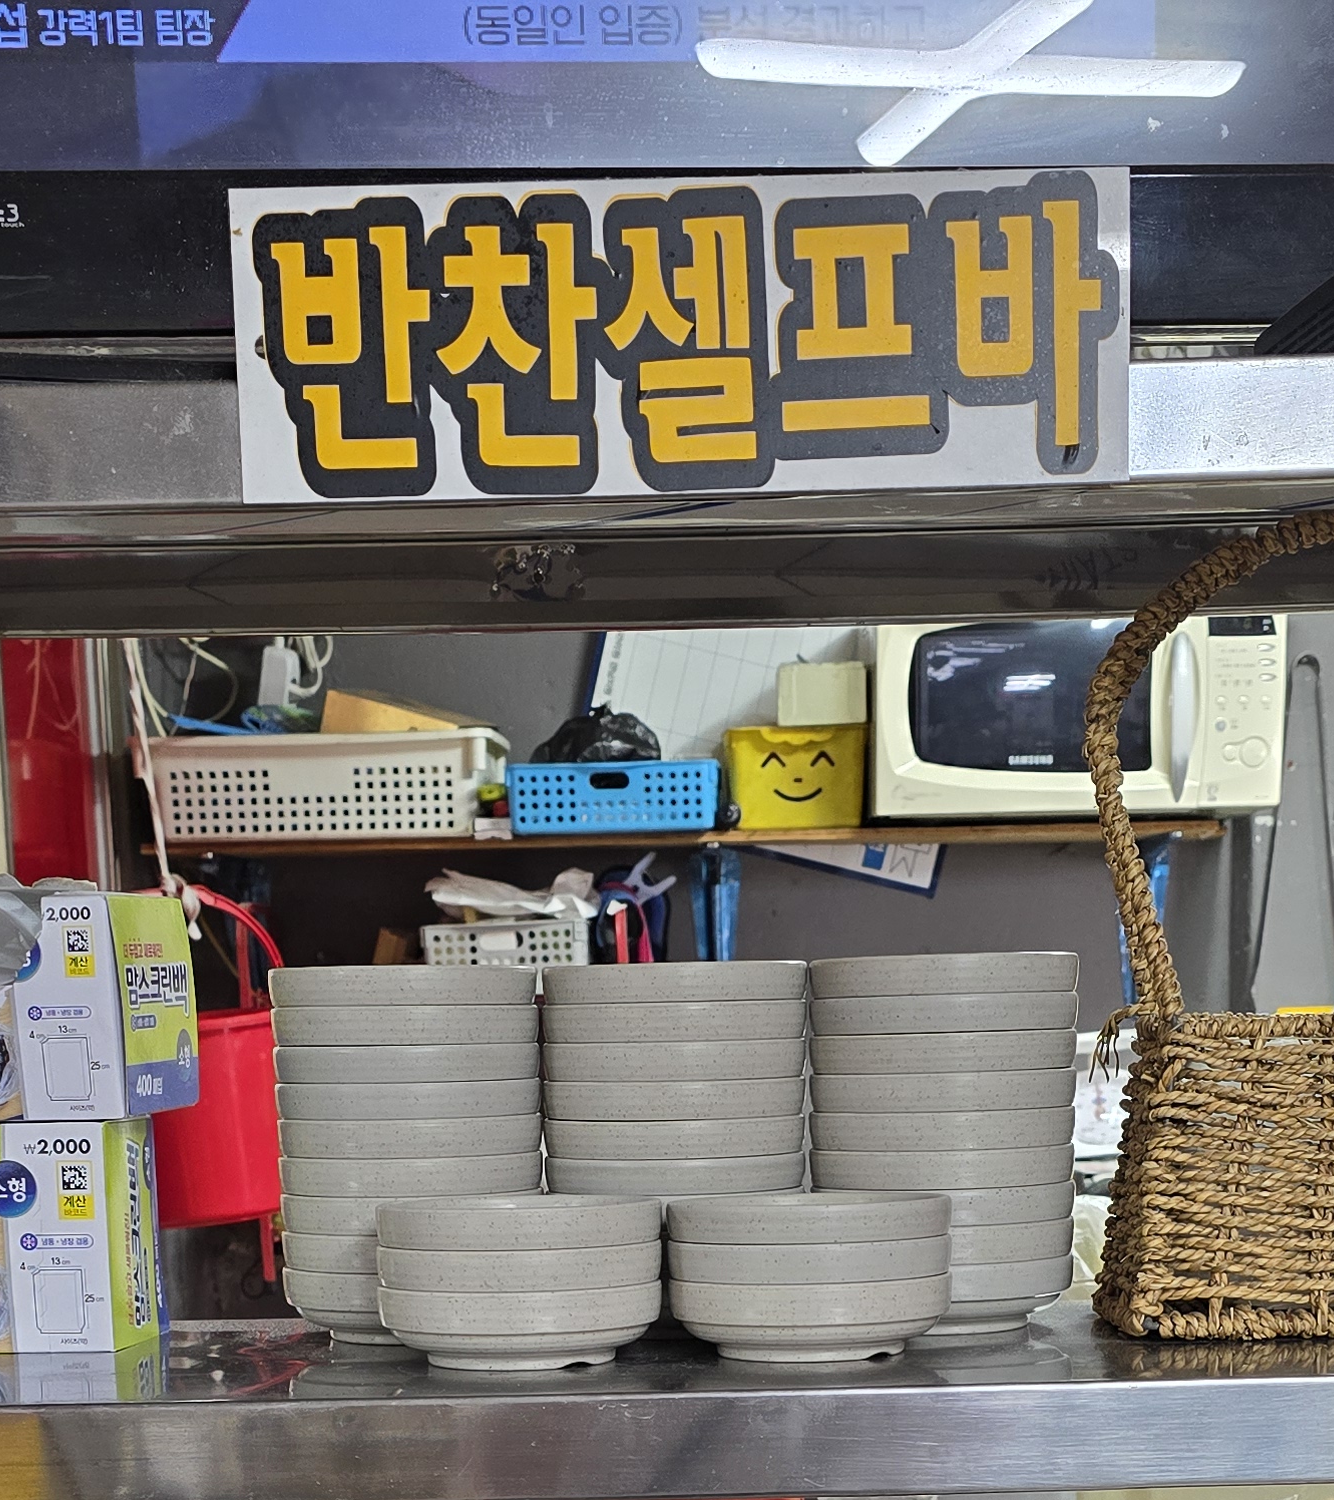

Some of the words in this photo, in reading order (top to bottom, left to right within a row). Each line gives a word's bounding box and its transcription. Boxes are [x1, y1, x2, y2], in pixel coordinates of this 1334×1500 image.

[37, 9, 145, 47] 강력1팀
[154, 9, 216, 46] 팀장
[463, 3, 586, 47] (동일인
[599, 4, 682, 47] 입증)
[69, 956, 88, 968] 계산
[125, 964, 189, 1016] 맘스크린백
[178, 1044, 191, 1069] 소형
[136, 1074, 152, 1097] 400
[63, 1195, 87, 1208] 계산
